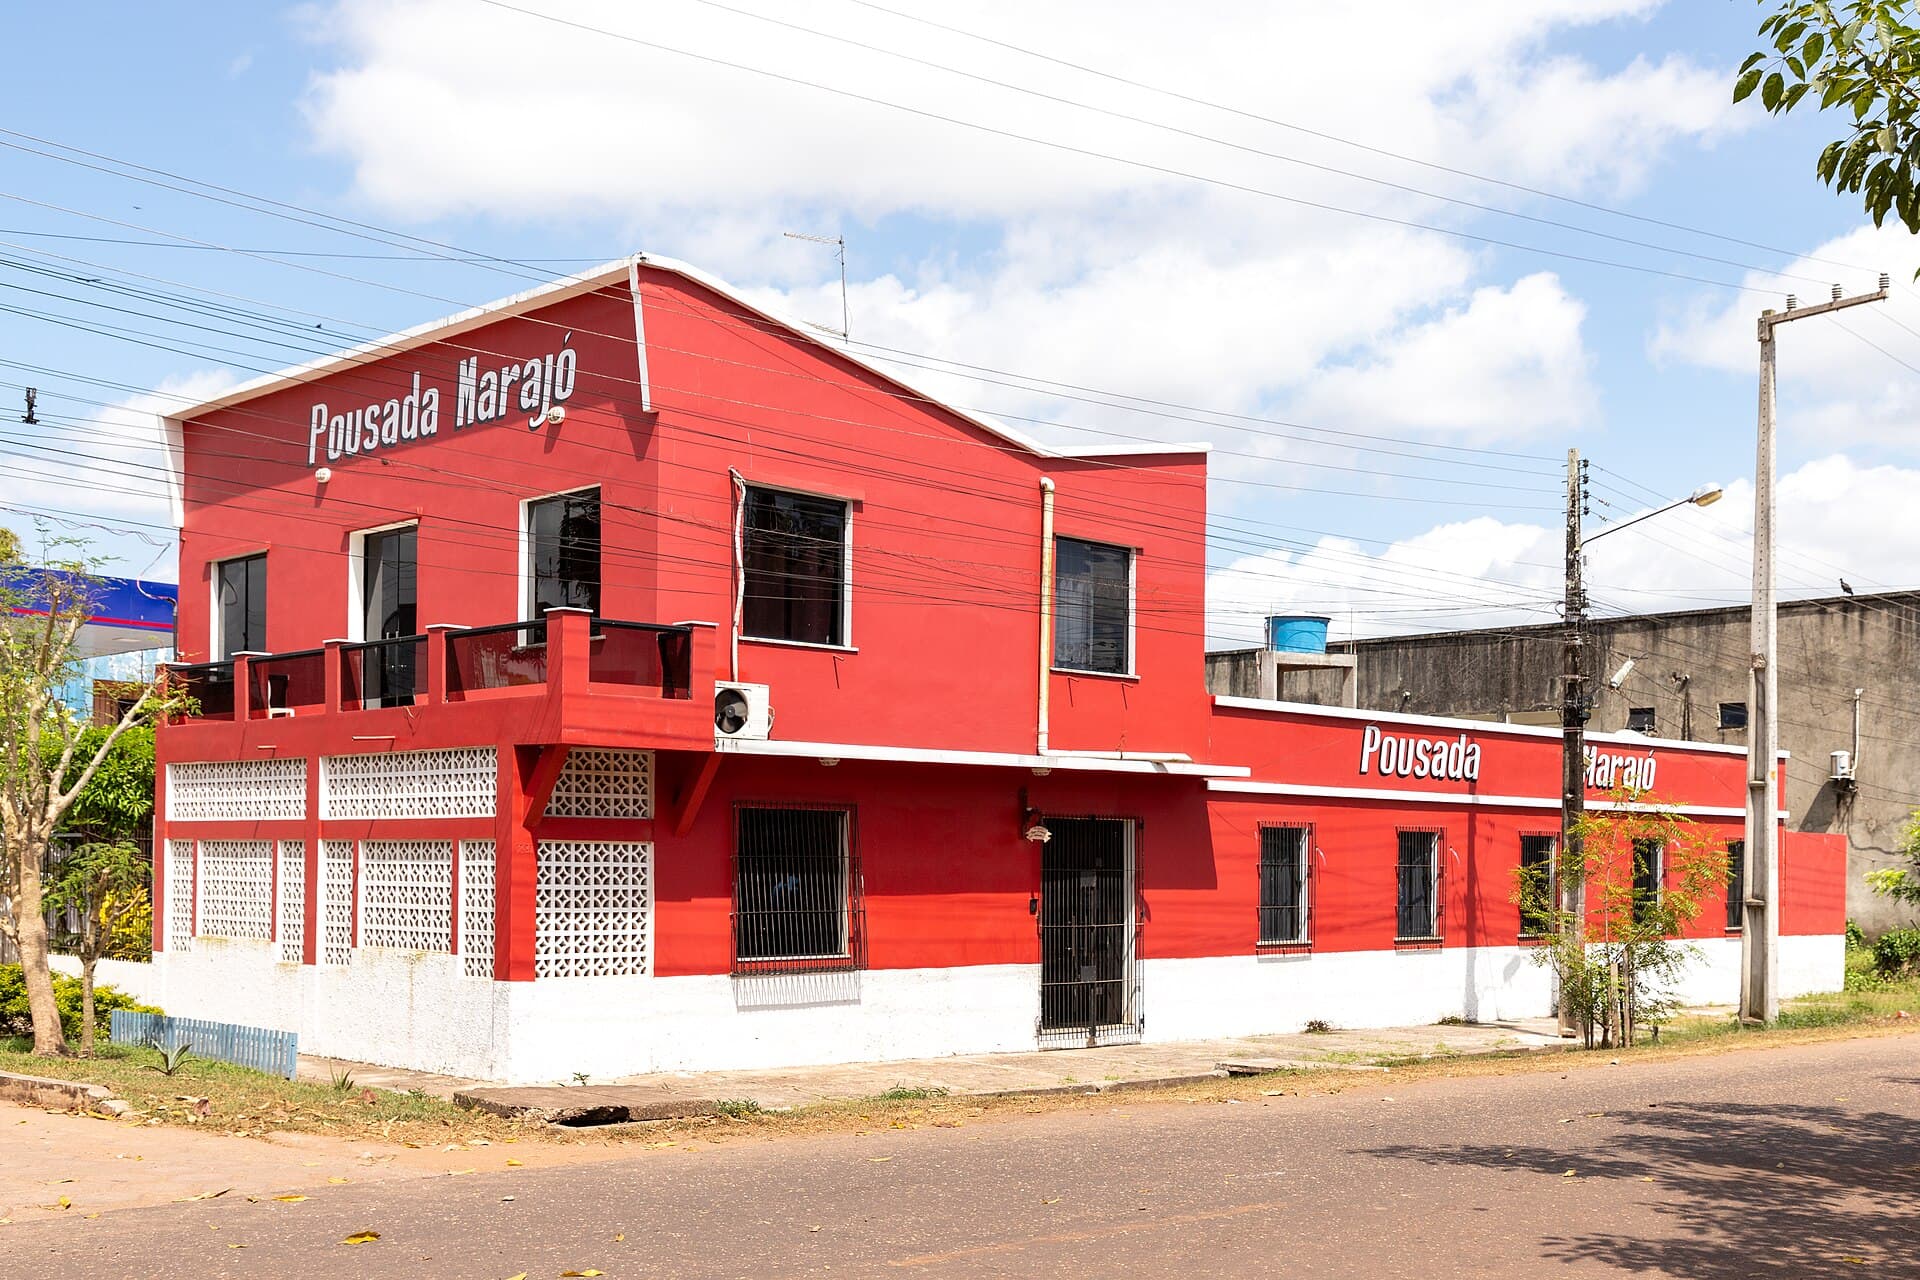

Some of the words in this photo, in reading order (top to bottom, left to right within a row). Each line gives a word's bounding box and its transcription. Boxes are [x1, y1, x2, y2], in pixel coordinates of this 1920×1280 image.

[308, 371, 439, 466] Pousada
[455, 331, 577, 430] Marajó
[1360, 725, 1481, 780] Pousada
